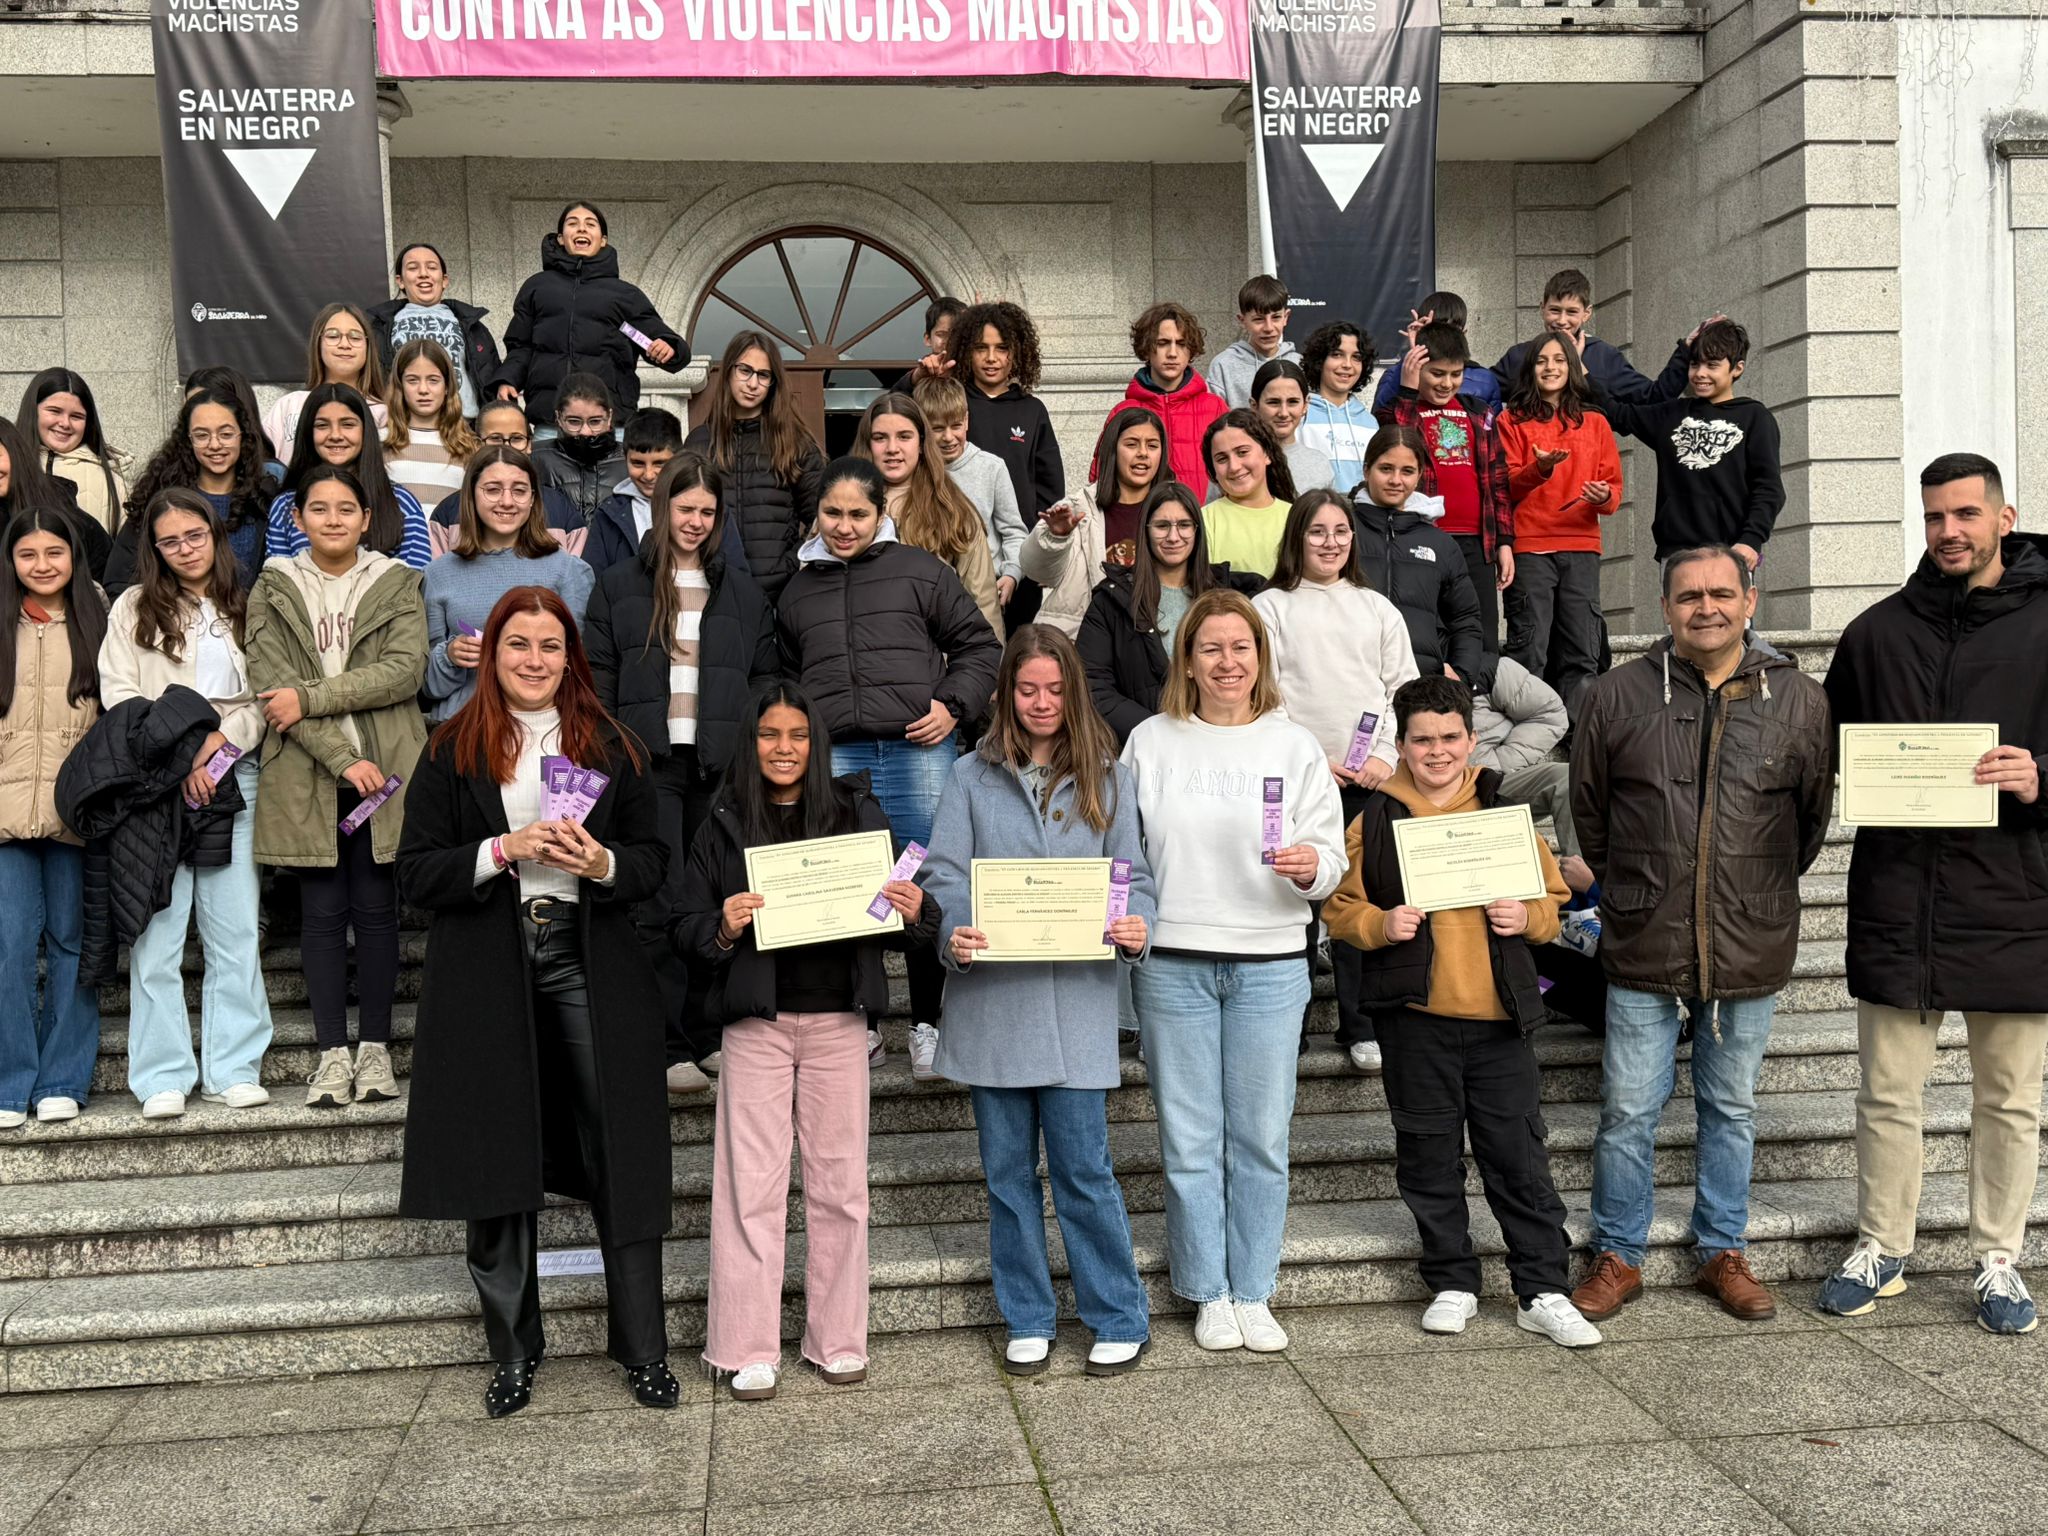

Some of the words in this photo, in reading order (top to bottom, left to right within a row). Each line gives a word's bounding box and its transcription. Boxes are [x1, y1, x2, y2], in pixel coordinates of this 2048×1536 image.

[170, 0, 299, 11] VIOLENCIAS
[168, 13, 299, 33] MACHISTAS
[400, 0, 587, 41] CONTRA
[601, 0, 664, 41] AS
[684, 0, 951, 42] VIOLENCIAS
[968, 0, 1224, 45] MACHISTAS
[1259, 14, 1376, 33] MACHISTAS
[178, 88, 356, 113] SALVATERRA
[1263, 86, 1422, 110] SALVATERRA
[180, 117, 215, 141] EN
[225, 116, 320, 141] NEGRO
[1263, 113, 1296, 136] EN
[1304, 112, 1390, 136] NEGRO
[1183, 767, 1288, 804] AMOU
